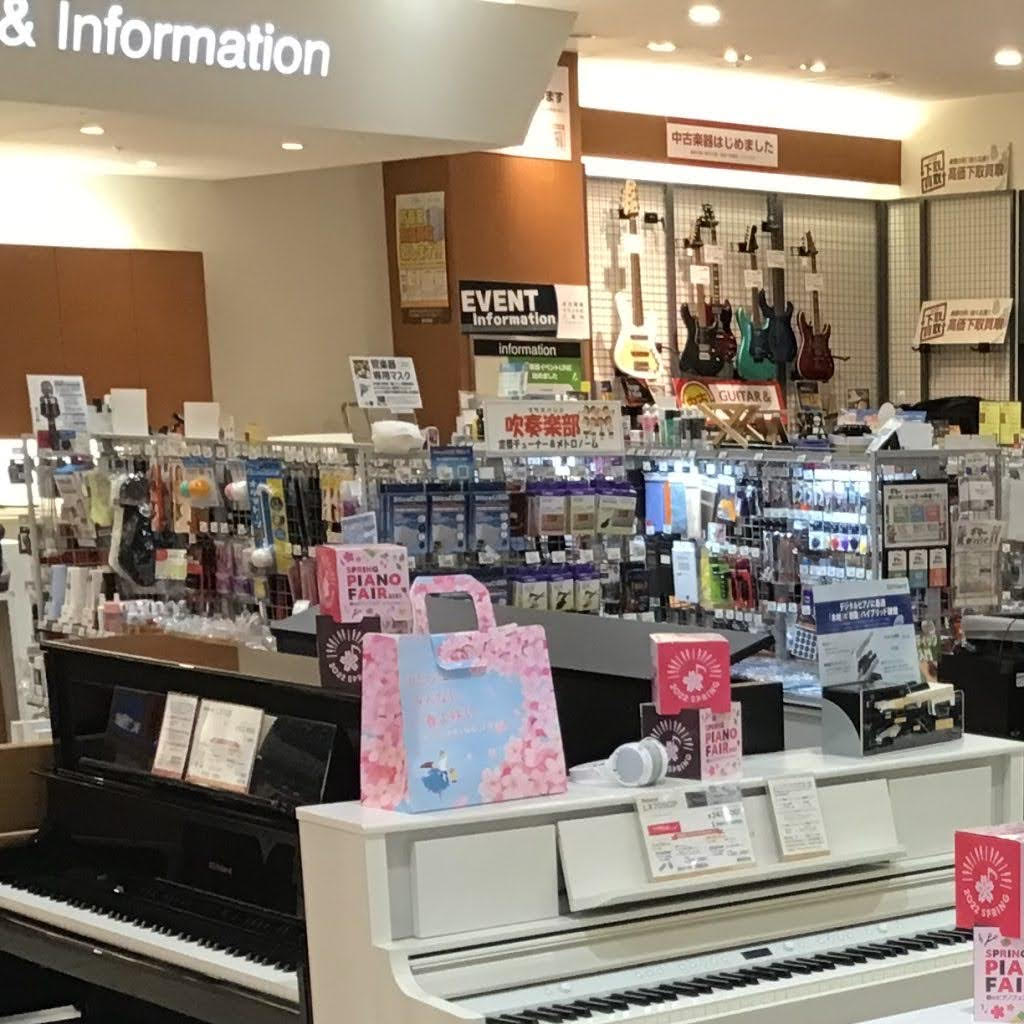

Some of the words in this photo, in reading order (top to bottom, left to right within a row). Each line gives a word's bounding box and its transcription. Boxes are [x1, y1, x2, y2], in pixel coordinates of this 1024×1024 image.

[0, 0, 36, 48] &
[57, 0, 332, 77] Information
[671, 131, 775, 155] 中古楽器はじめました
[460, 288, 539, 313] EVENT
[472, 312, 556, 327] Information
[498, 343, 557, 357] information
[347, 573, 401, 588] PIANO
[348, 587, 389, 601] FAIR
[705, 728, 738, 744] PIANO
[980, 894, 1011, 919] SPRING
